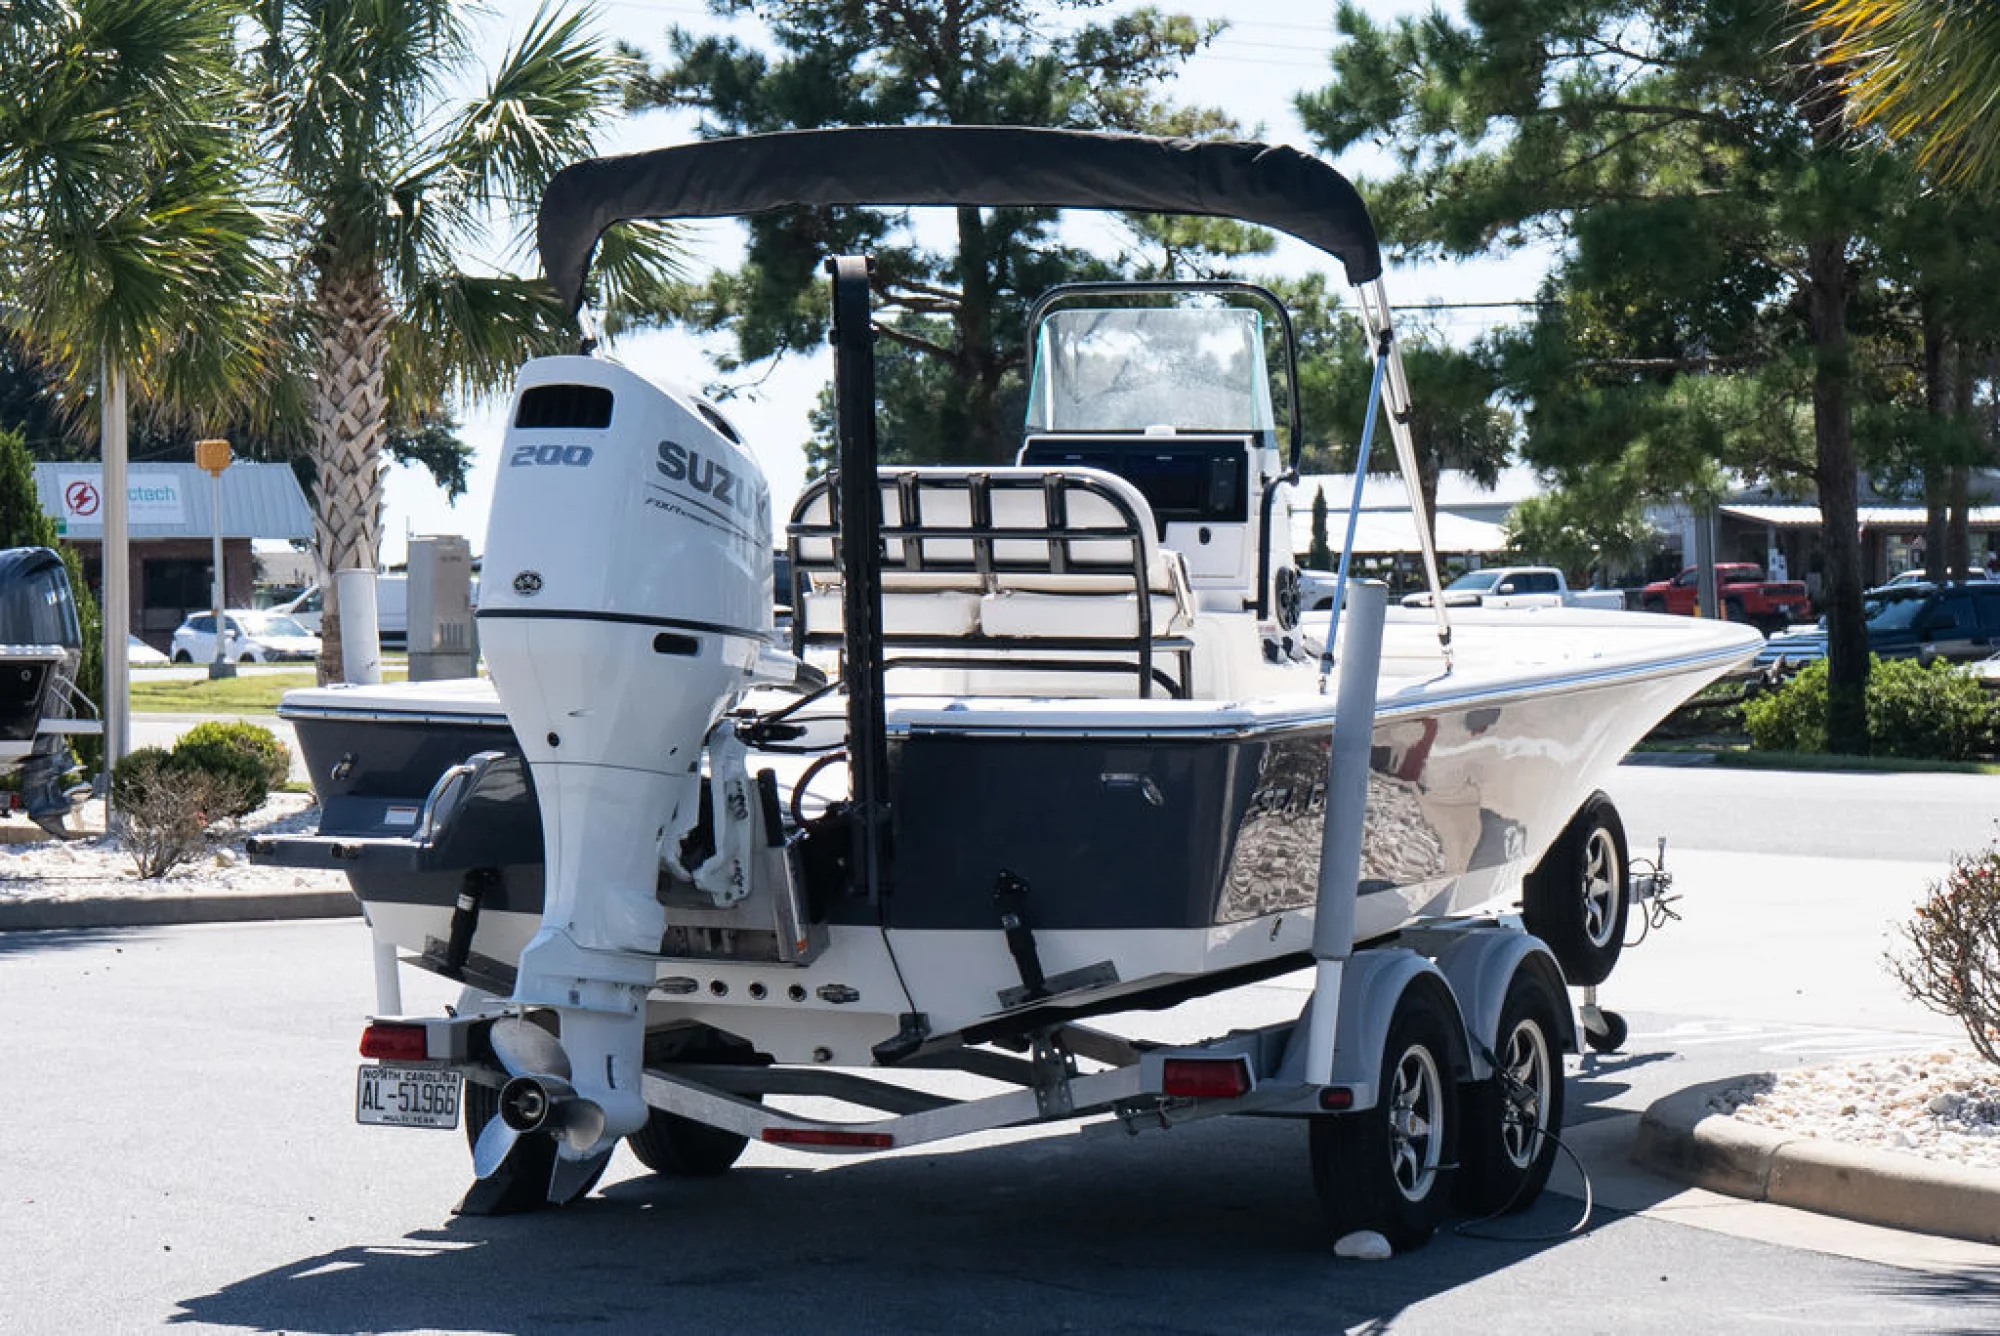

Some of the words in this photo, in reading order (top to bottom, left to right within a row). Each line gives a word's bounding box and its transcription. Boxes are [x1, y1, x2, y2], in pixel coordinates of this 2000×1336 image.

[510, 445, 594, 467] 200
[128, 486, 176, 501] ctech
[656, 440, 771, 540] SUZUK
[363, 1069, 400, 1080] NORTH
[406, 1071, 457, 1083] CAROLINA
[361, 1081, 456, 1115] AL-51966
